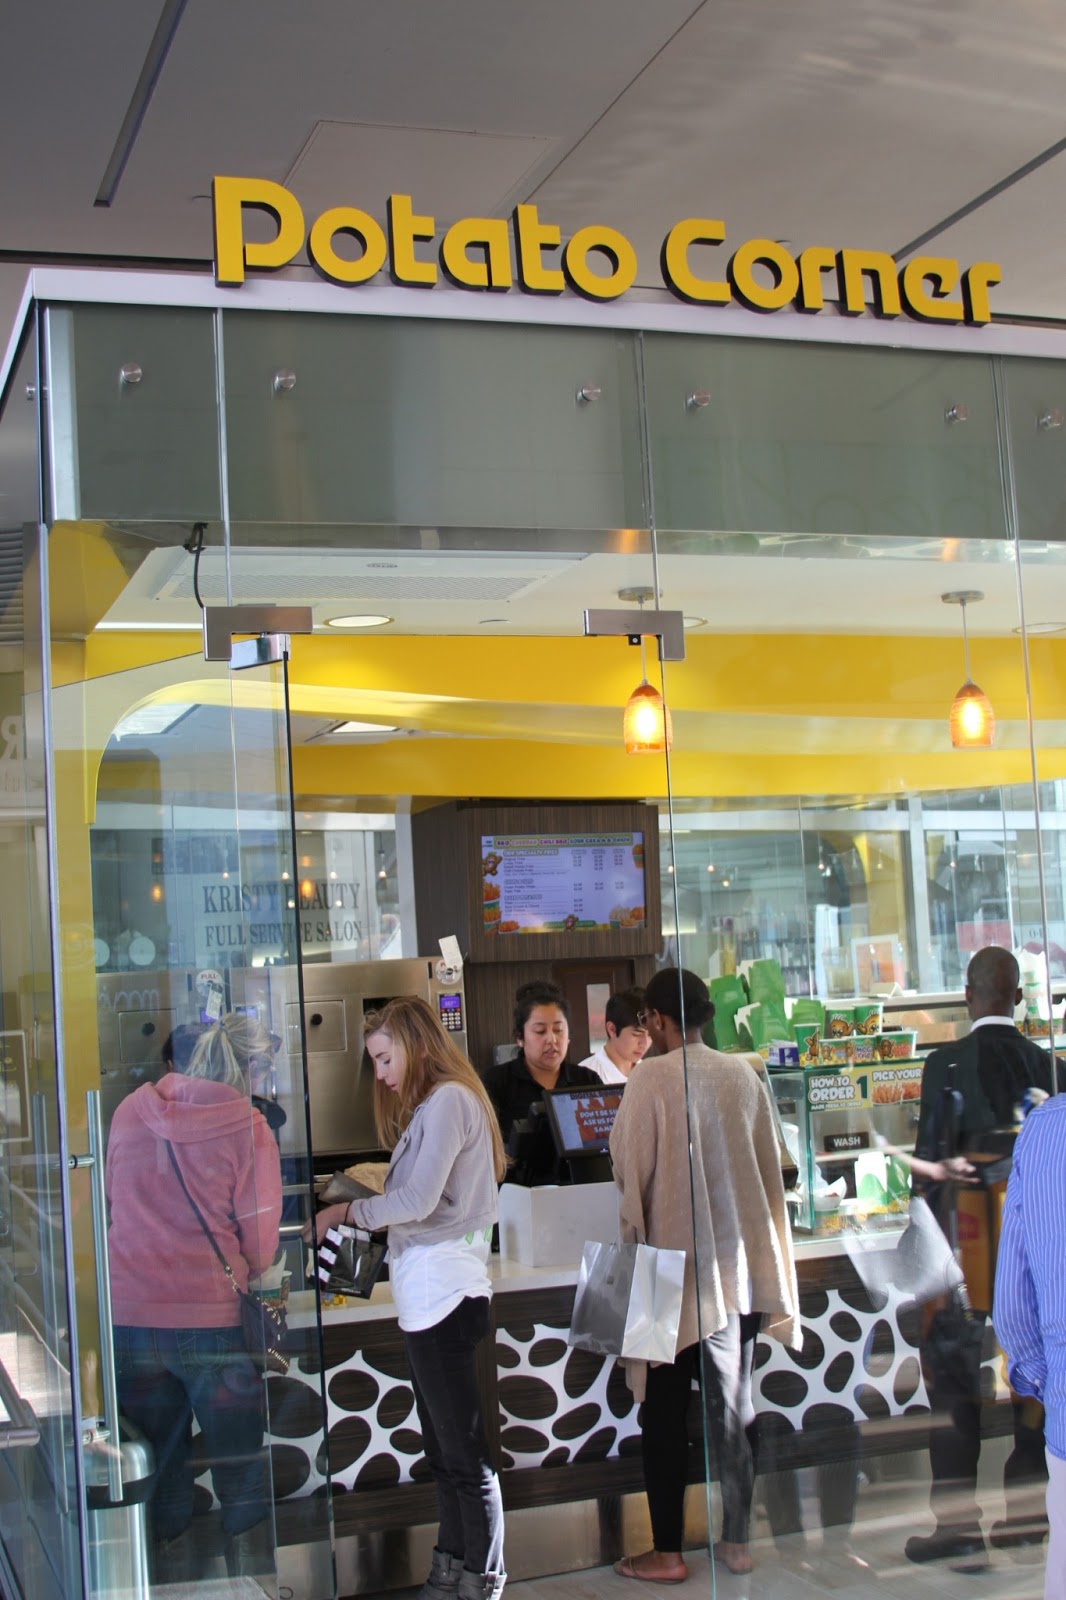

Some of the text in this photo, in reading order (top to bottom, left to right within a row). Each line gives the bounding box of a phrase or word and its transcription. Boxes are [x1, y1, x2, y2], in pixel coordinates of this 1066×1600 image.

[211, 174, 1003, 325] Potato Corner
[202, 883, 279, 914] KRISTY
[205, 920, 362, 947] FULL SERVIE SALON
[811, 1075, 850, 1088] HOW TO
[873, 1068, 921, 1082] PICK YOUR
[810, 1087, 854, 1101] ORDER
[856, 1074, 868, 1100] 1
[833, 1136, 861, 1147] WASH
